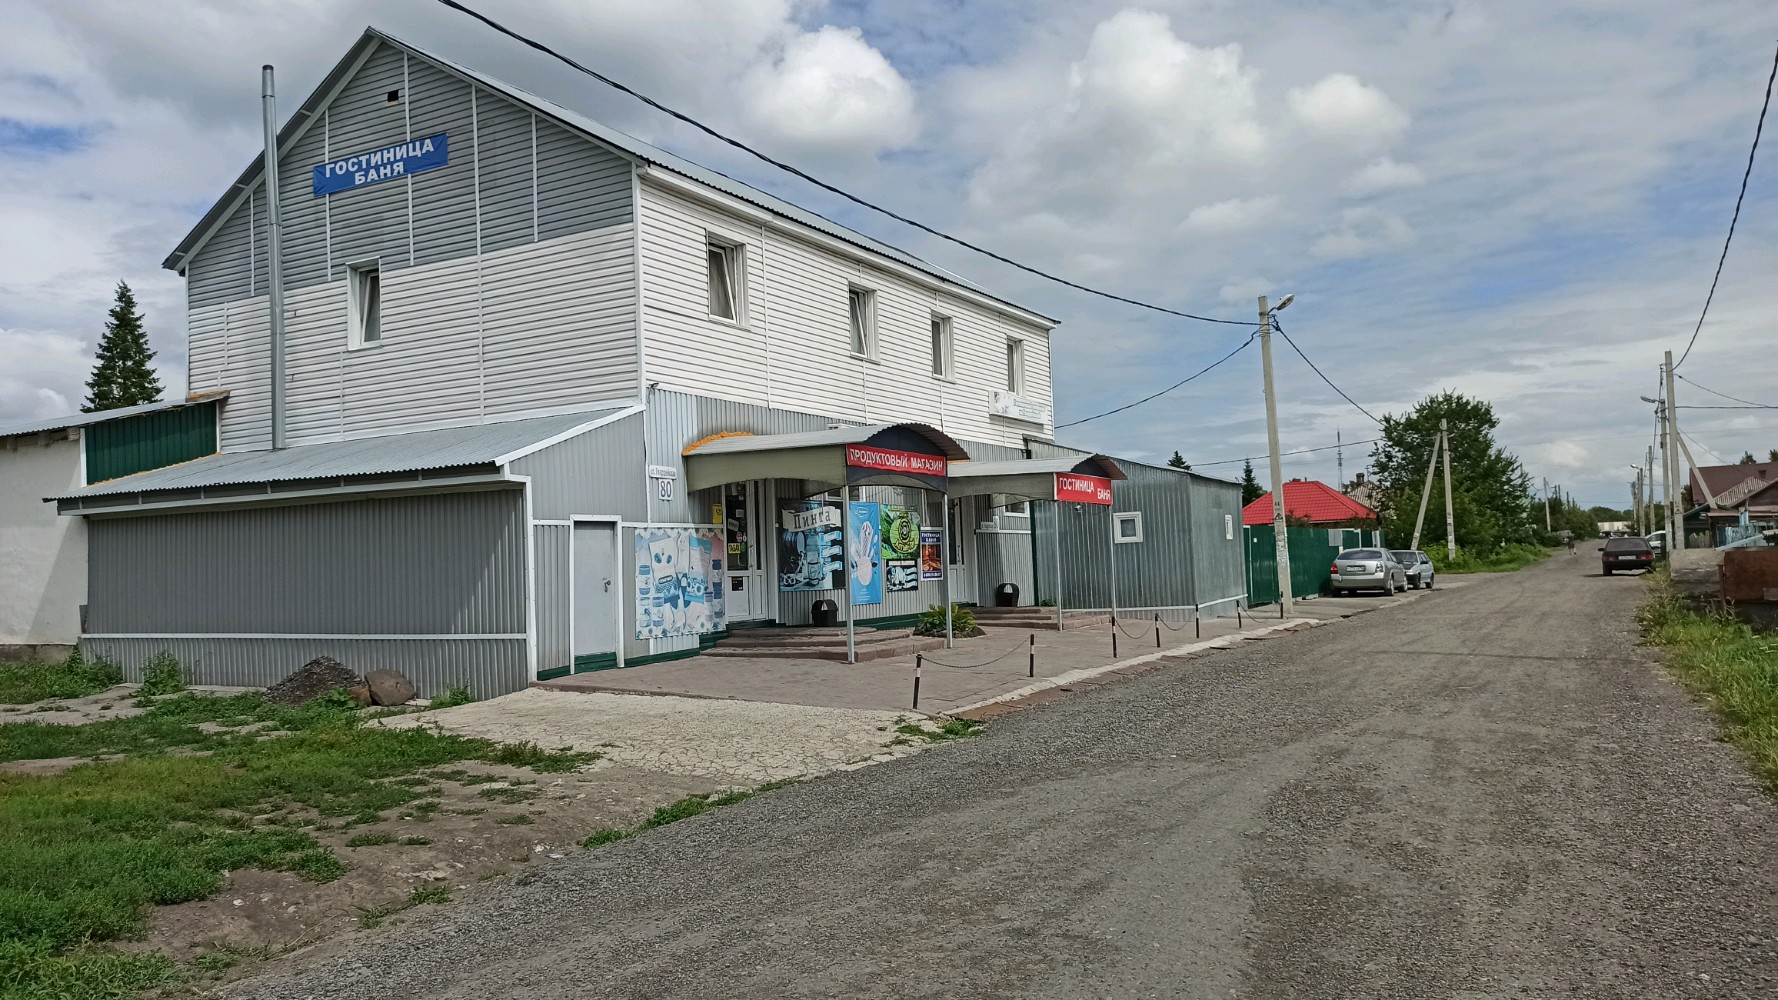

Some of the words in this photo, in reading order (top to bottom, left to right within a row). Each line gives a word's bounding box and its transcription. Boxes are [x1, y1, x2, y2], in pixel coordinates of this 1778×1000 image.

[325, 138, 434, 178] ГОСТИНИЦА
[354, 161, 404, 185] БАНЯ
[849, 448, 908, 467] ПРОДУКТОВЫЙ
[910, 457, 943, 471] МАГАЗИН
[660, 480, 672, 498] 80
[1059, 478, 1094, 494] ГОСТИНИЦА
[1097, 488, 1111, 500] БАНЯ
[793, 510, 831, 529] Пинта
